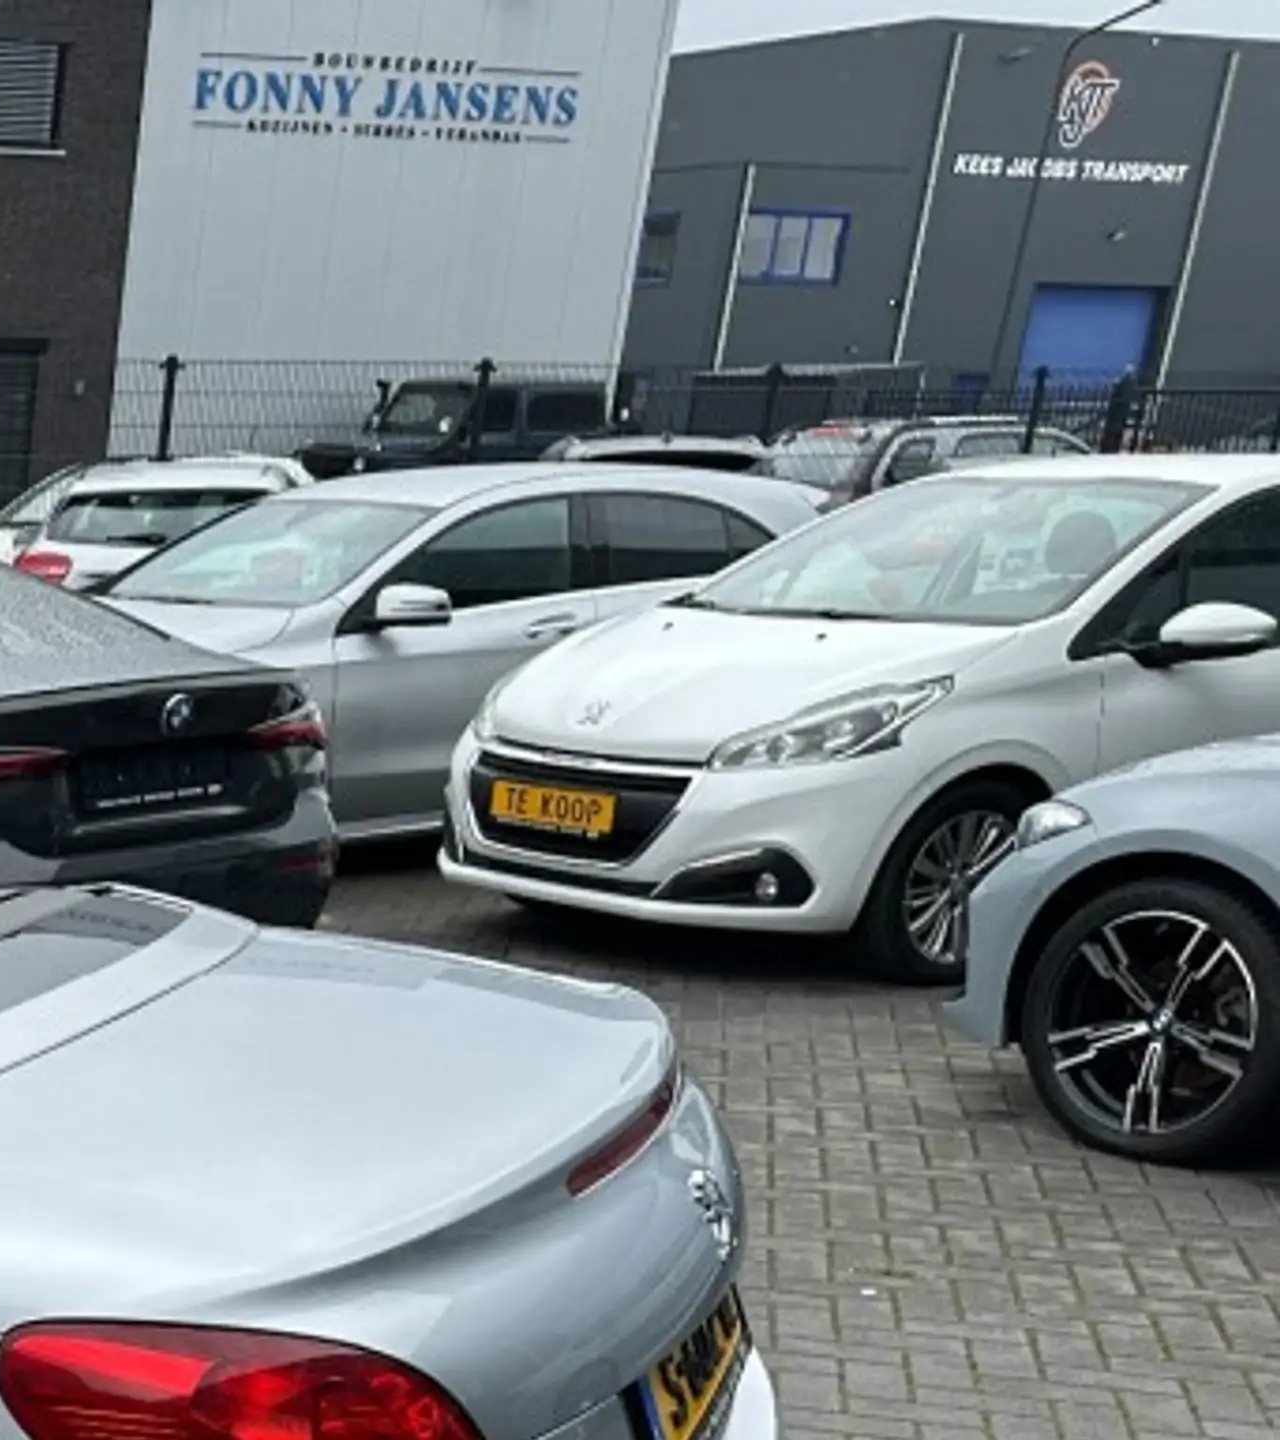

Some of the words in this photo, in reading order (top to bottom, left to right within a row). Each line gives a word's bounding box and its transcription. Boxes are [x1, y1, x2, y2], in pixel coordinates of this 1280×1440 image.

[194, 70, 362, 117] FONNY
[374, 79, 578, 126] JANSENS
[954, 153, 1003, 177] KEES
[1082, 161, 1190, 184] TRANSPORT
[505, 787, 530, 815] TE
[541, 791, 603, 824] KOOP
